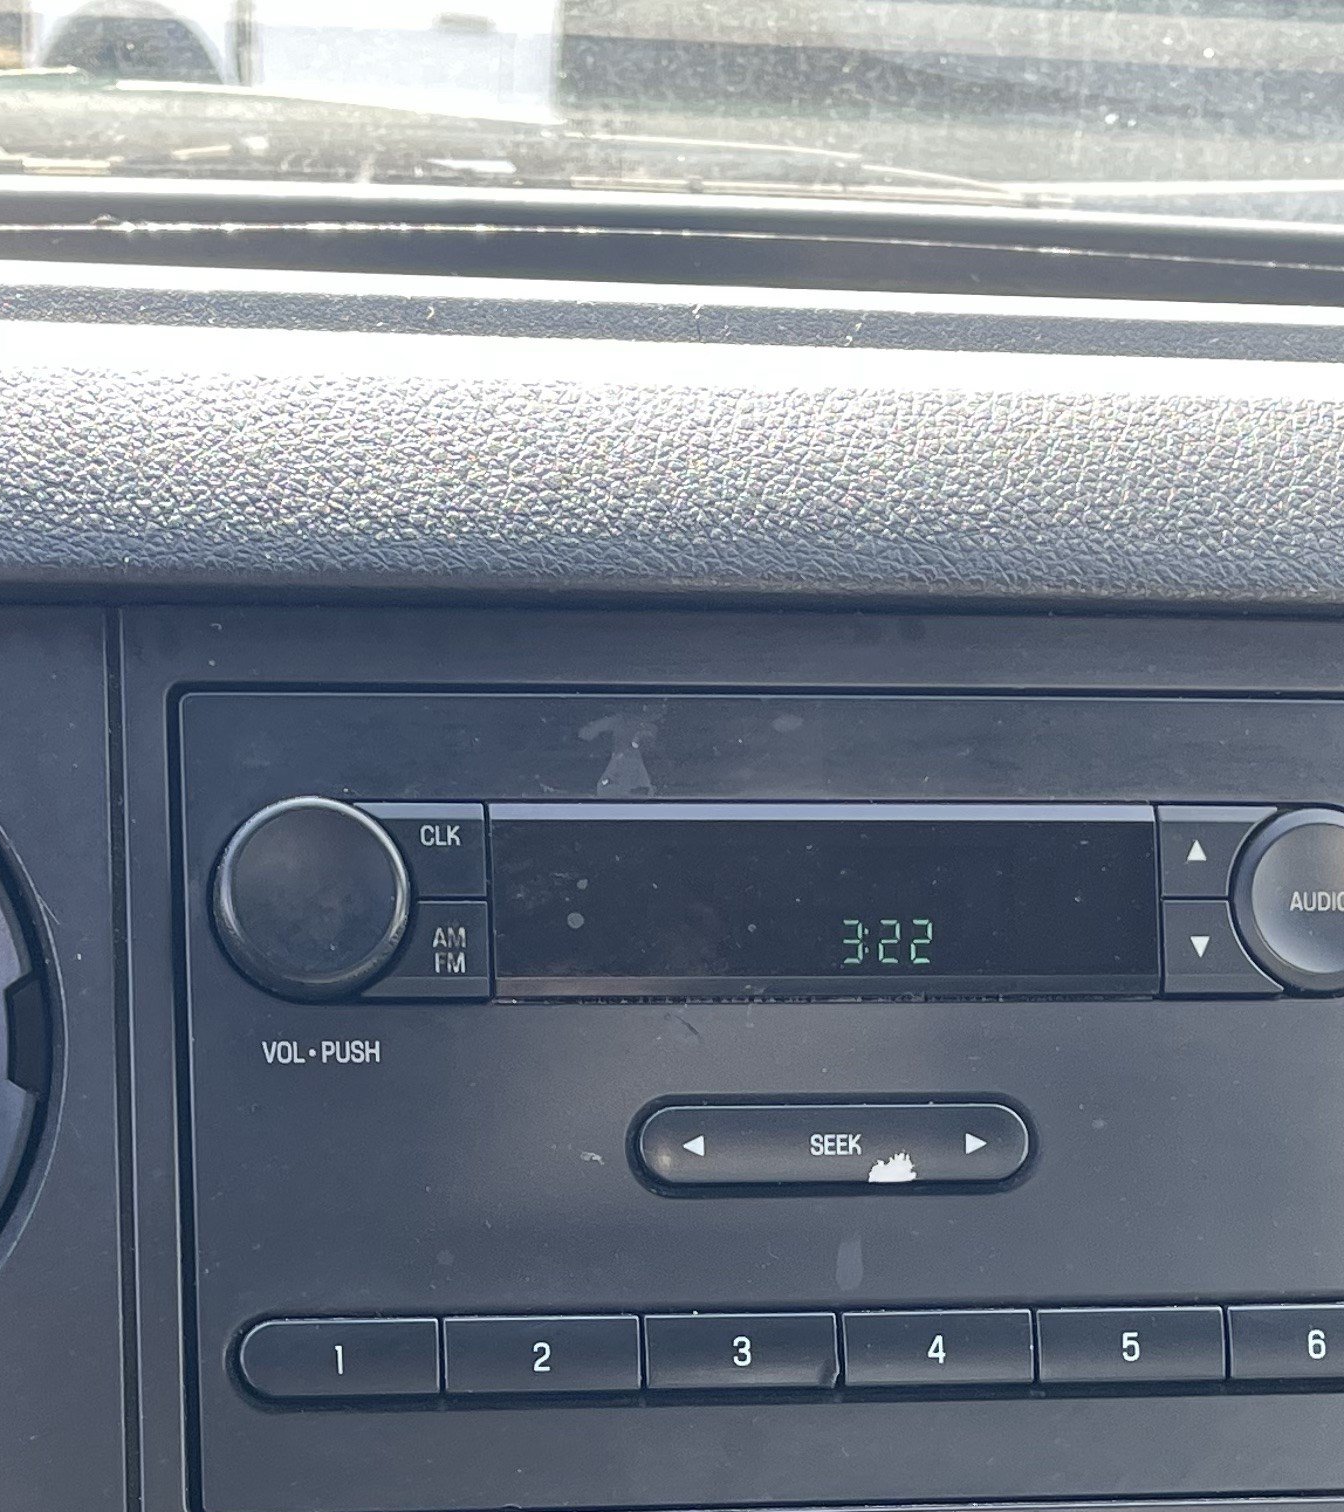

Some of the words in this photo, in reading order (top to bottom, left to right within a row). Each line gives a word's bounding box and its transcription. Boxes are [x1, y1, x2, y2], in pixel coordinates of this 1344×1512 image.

[420, 824, 461, 846] CLK
[432, 927, 467, 948] AM
[843, 919, 933, 963] 3:22
[434, 952, 466, 973] FM
[262, 1041, 306, 1064] VOL
[322, 1041, 381, 1063] PUSH
[809, 1134, 862, 1156] SEEK
[532, 1343, 552, 1374] 2
[732, 1337, 752, 1367] 3
[926, 1335, 948, 1365] 4
[1122, 1332, 1142, 1363] 5
[1308, 1329, 1328, 1361] 6
[335, 1346, 346, 1376] 1
